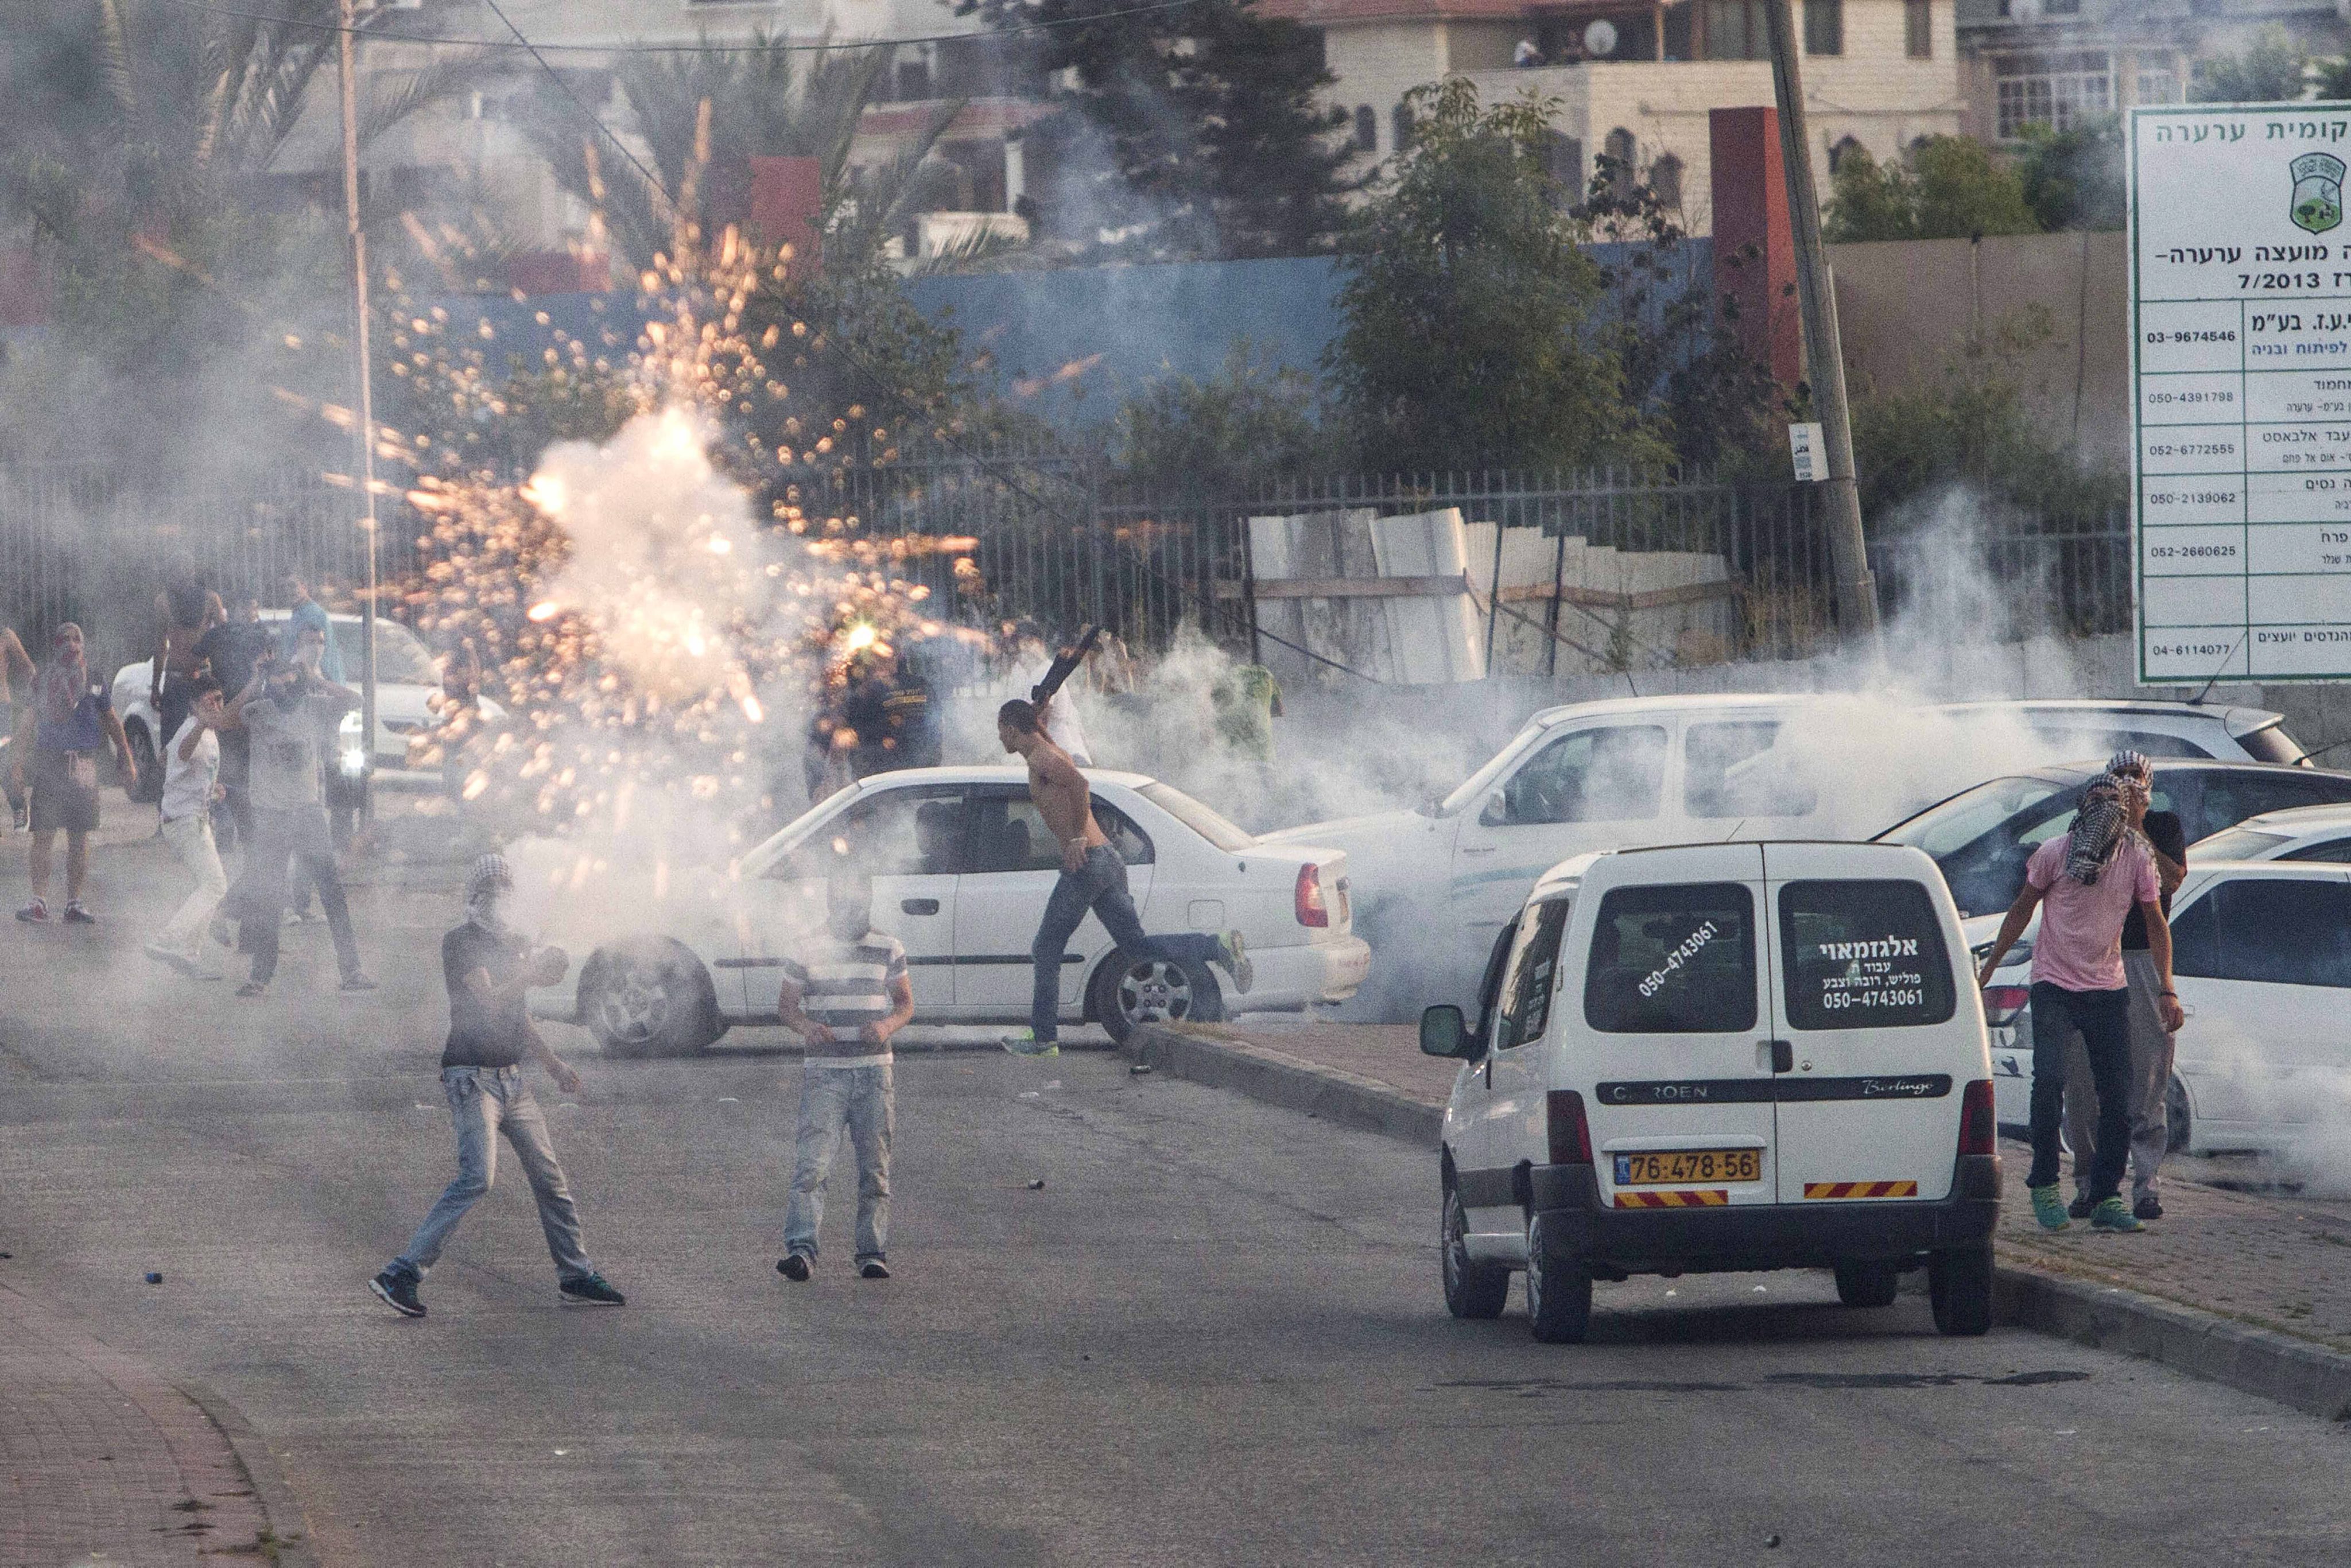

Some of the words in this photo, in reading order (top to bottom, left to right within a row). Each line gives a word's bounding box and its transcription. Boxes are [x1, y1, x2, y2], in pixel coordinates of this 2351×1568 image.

[2156, 123, 2245, 143] ערערה
[2267, 121, 2348, 142] קומית
[2256, 245, 2328, 262] מועצה
[2238, 272, 2319, 289] 7/2013
[2147, 331, 2236, 343] 03-9674546
[2251, 344, 2287, 355] ובניה
[2296, 340, 2347, 354] לפיתוח
[2325, 431, 2350, 441] עבד
[2306, 479, 2336, 489] נסים
[2150, 492, 2236, 504] 050-2139062
[2322, 533, 2348, 542] פרח
[2258, 632, 2296, 642] יועצים
[2153, 645, 2229, 655] 04-6114077
[1819, 935, 1918, 960] אלגזמאוי
[1639, 921, 1718, 997] 050-4743061
[1854, 975, 1881, 987] רובה
[1823, 989, 1922, 1009] 050-4743061
